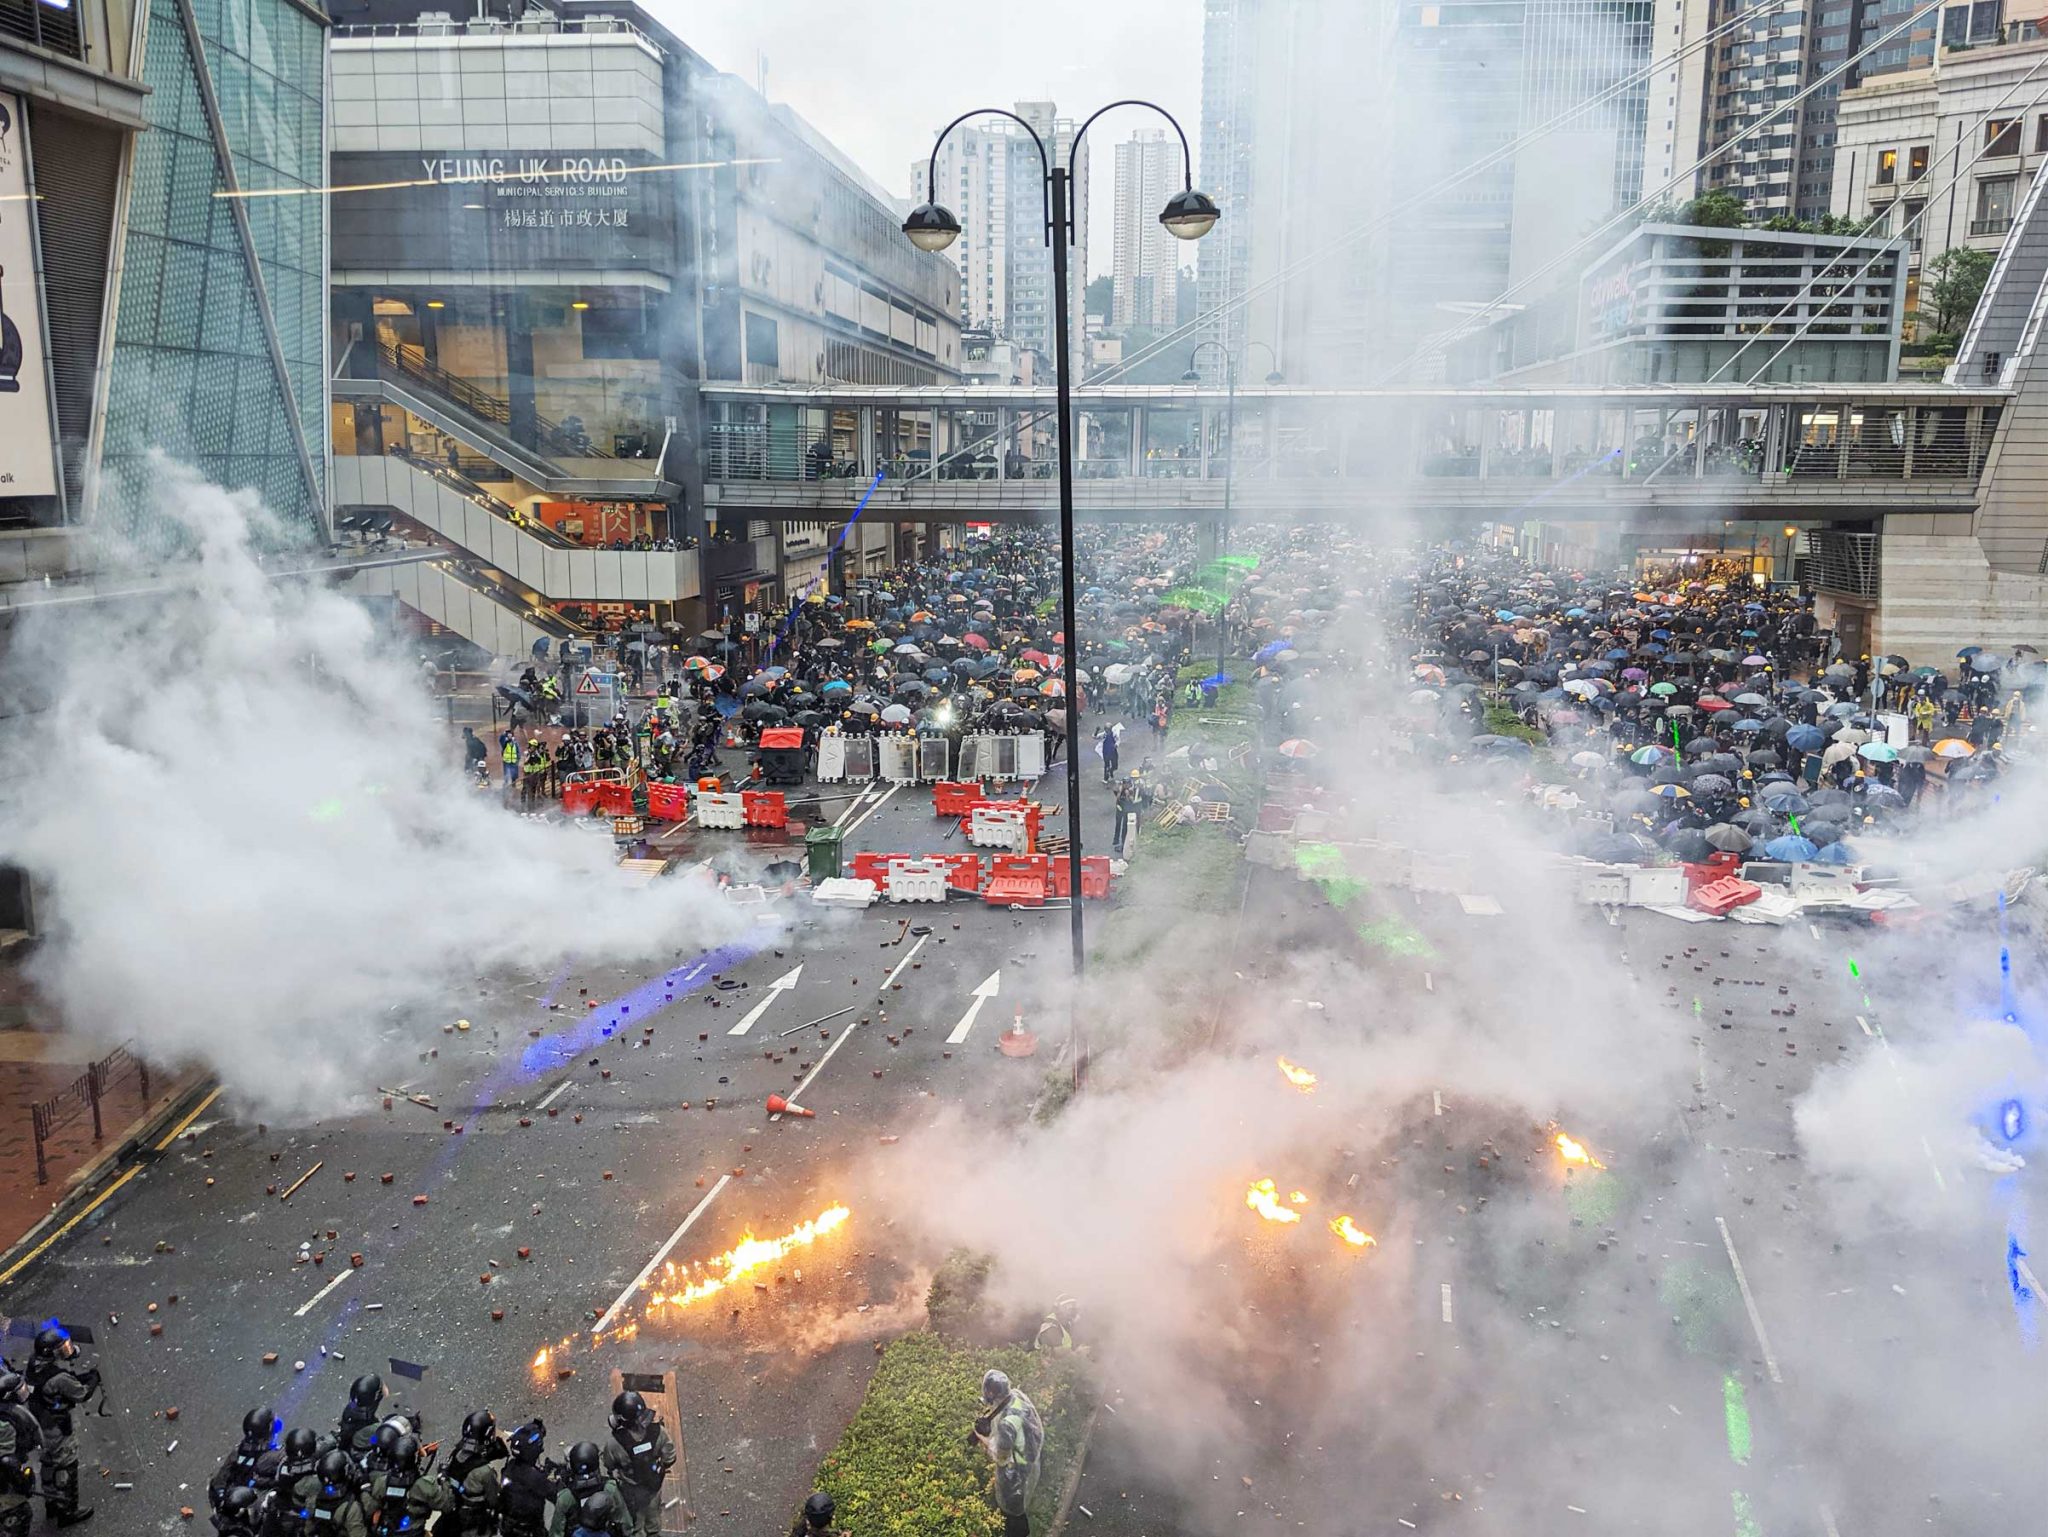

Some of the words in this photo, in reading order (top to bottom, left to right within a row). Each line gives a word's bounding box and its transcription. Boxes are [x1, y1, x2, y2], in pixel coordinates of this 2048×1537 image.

[422, 158, 504, 184] YEUNG
[520, 158, 549, 184] UK
[562, 157, 627, 184] ROAD
[497, 187, 542, 197] MUNICIPAL
[544, 186, 585, 197] SERVICES
[587, 186, 628, 197] BUILDING
[504, 208, 628, 228] 楊屋道市政大廈
